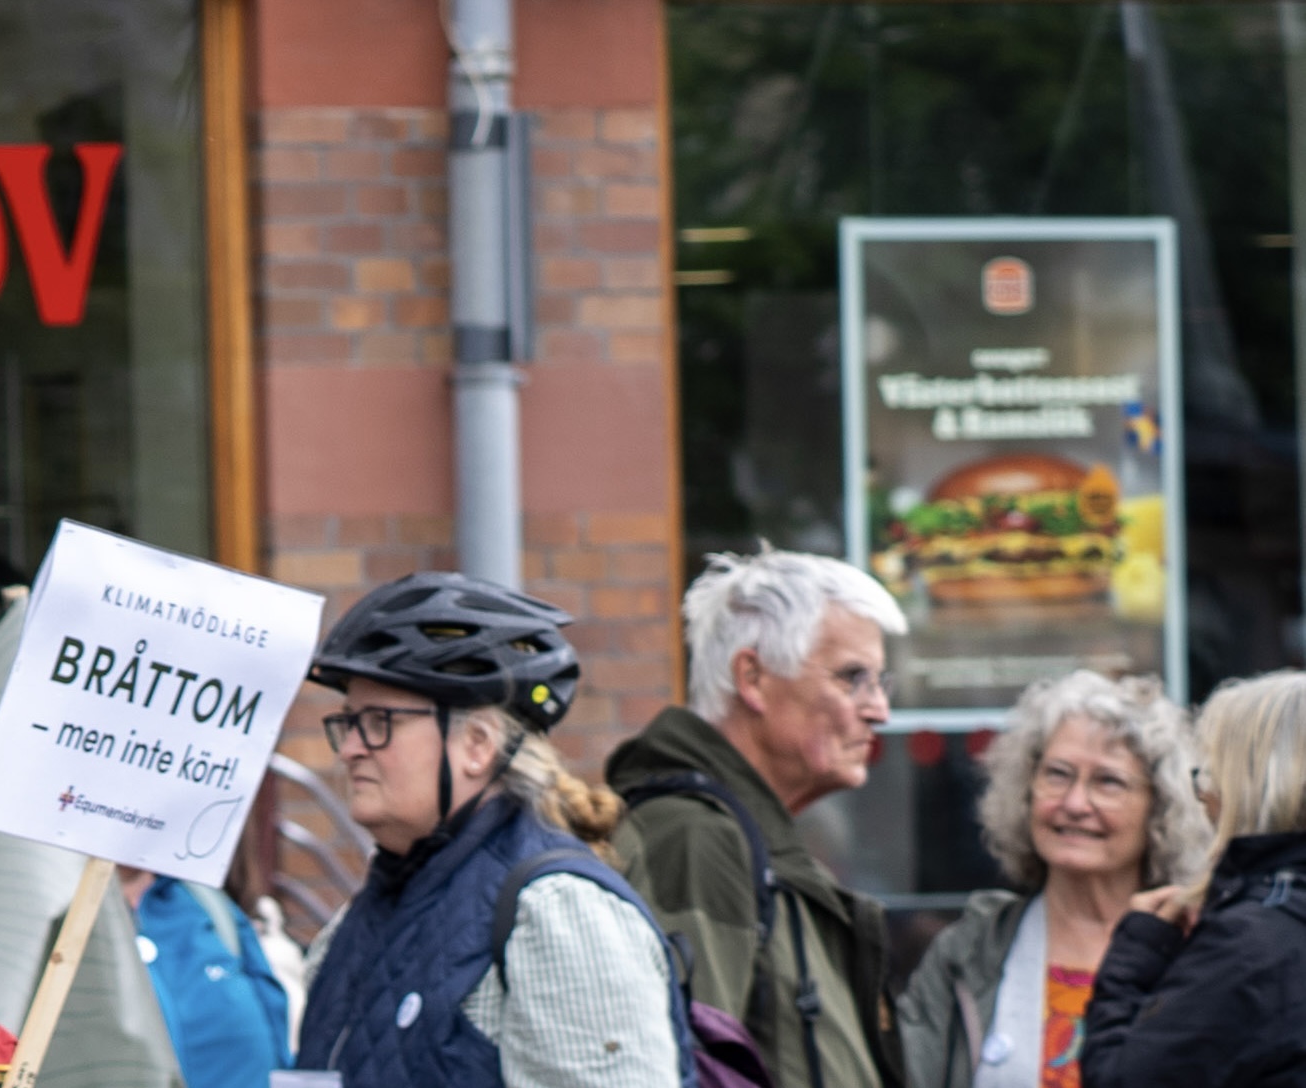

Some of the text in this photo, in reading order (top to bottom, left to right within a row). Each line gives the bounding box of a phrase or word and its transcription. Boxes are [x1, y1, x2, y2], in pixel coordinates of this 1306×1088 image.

[101, 583, 270, 649] KLIMATNÖDLÄGE
[50, 635, 263, 735] BRÅTTOM
[55, 720, 116, 758] men
[120, 729, 174, 774] inte
[177, 744, 240, 791] kört!
